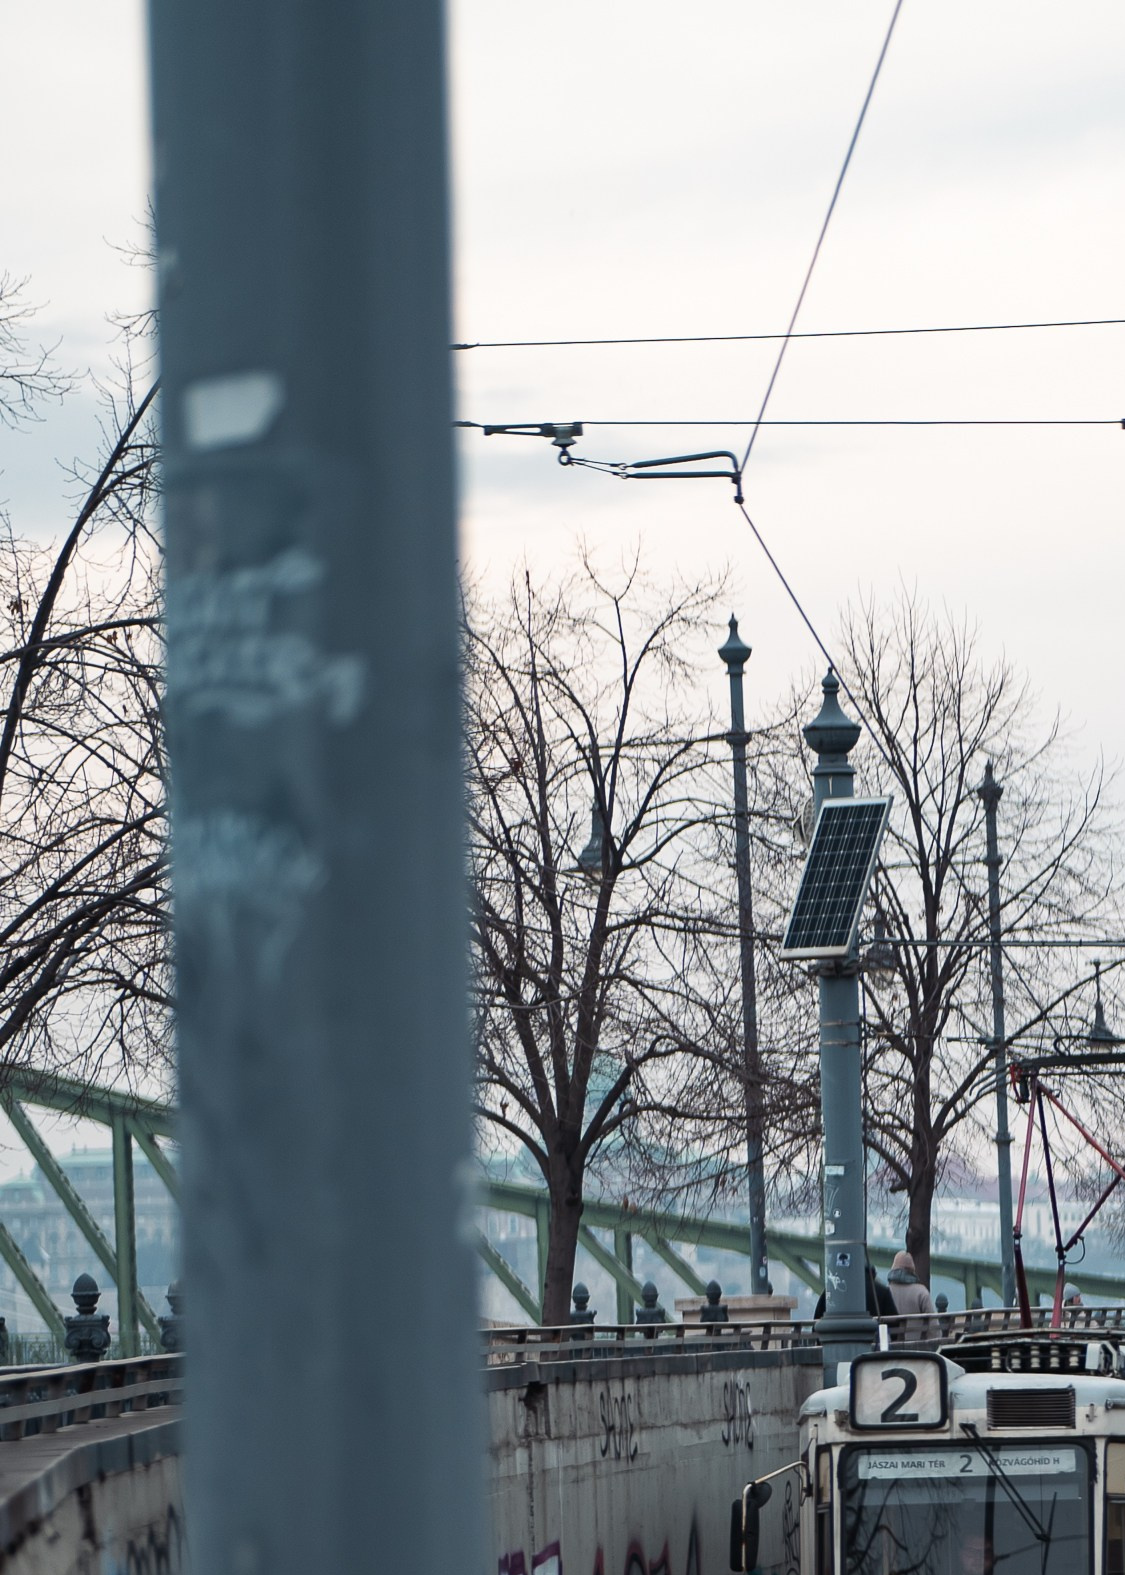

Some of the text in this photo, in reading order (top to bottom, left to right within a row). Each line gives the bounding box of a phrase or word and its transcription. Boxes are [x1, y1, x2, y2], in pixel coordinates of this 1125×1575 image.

[880, 1368, 919, 1423] 2
[867, 1459, 898, 1470] JÁSZAI
[901, 1460, 926, 1469] MARI
[928, 1459, 946, 1468] TÉR
[959, 1454, 973, 1473] 2
[1053, 1457, 1061, 1465] H
